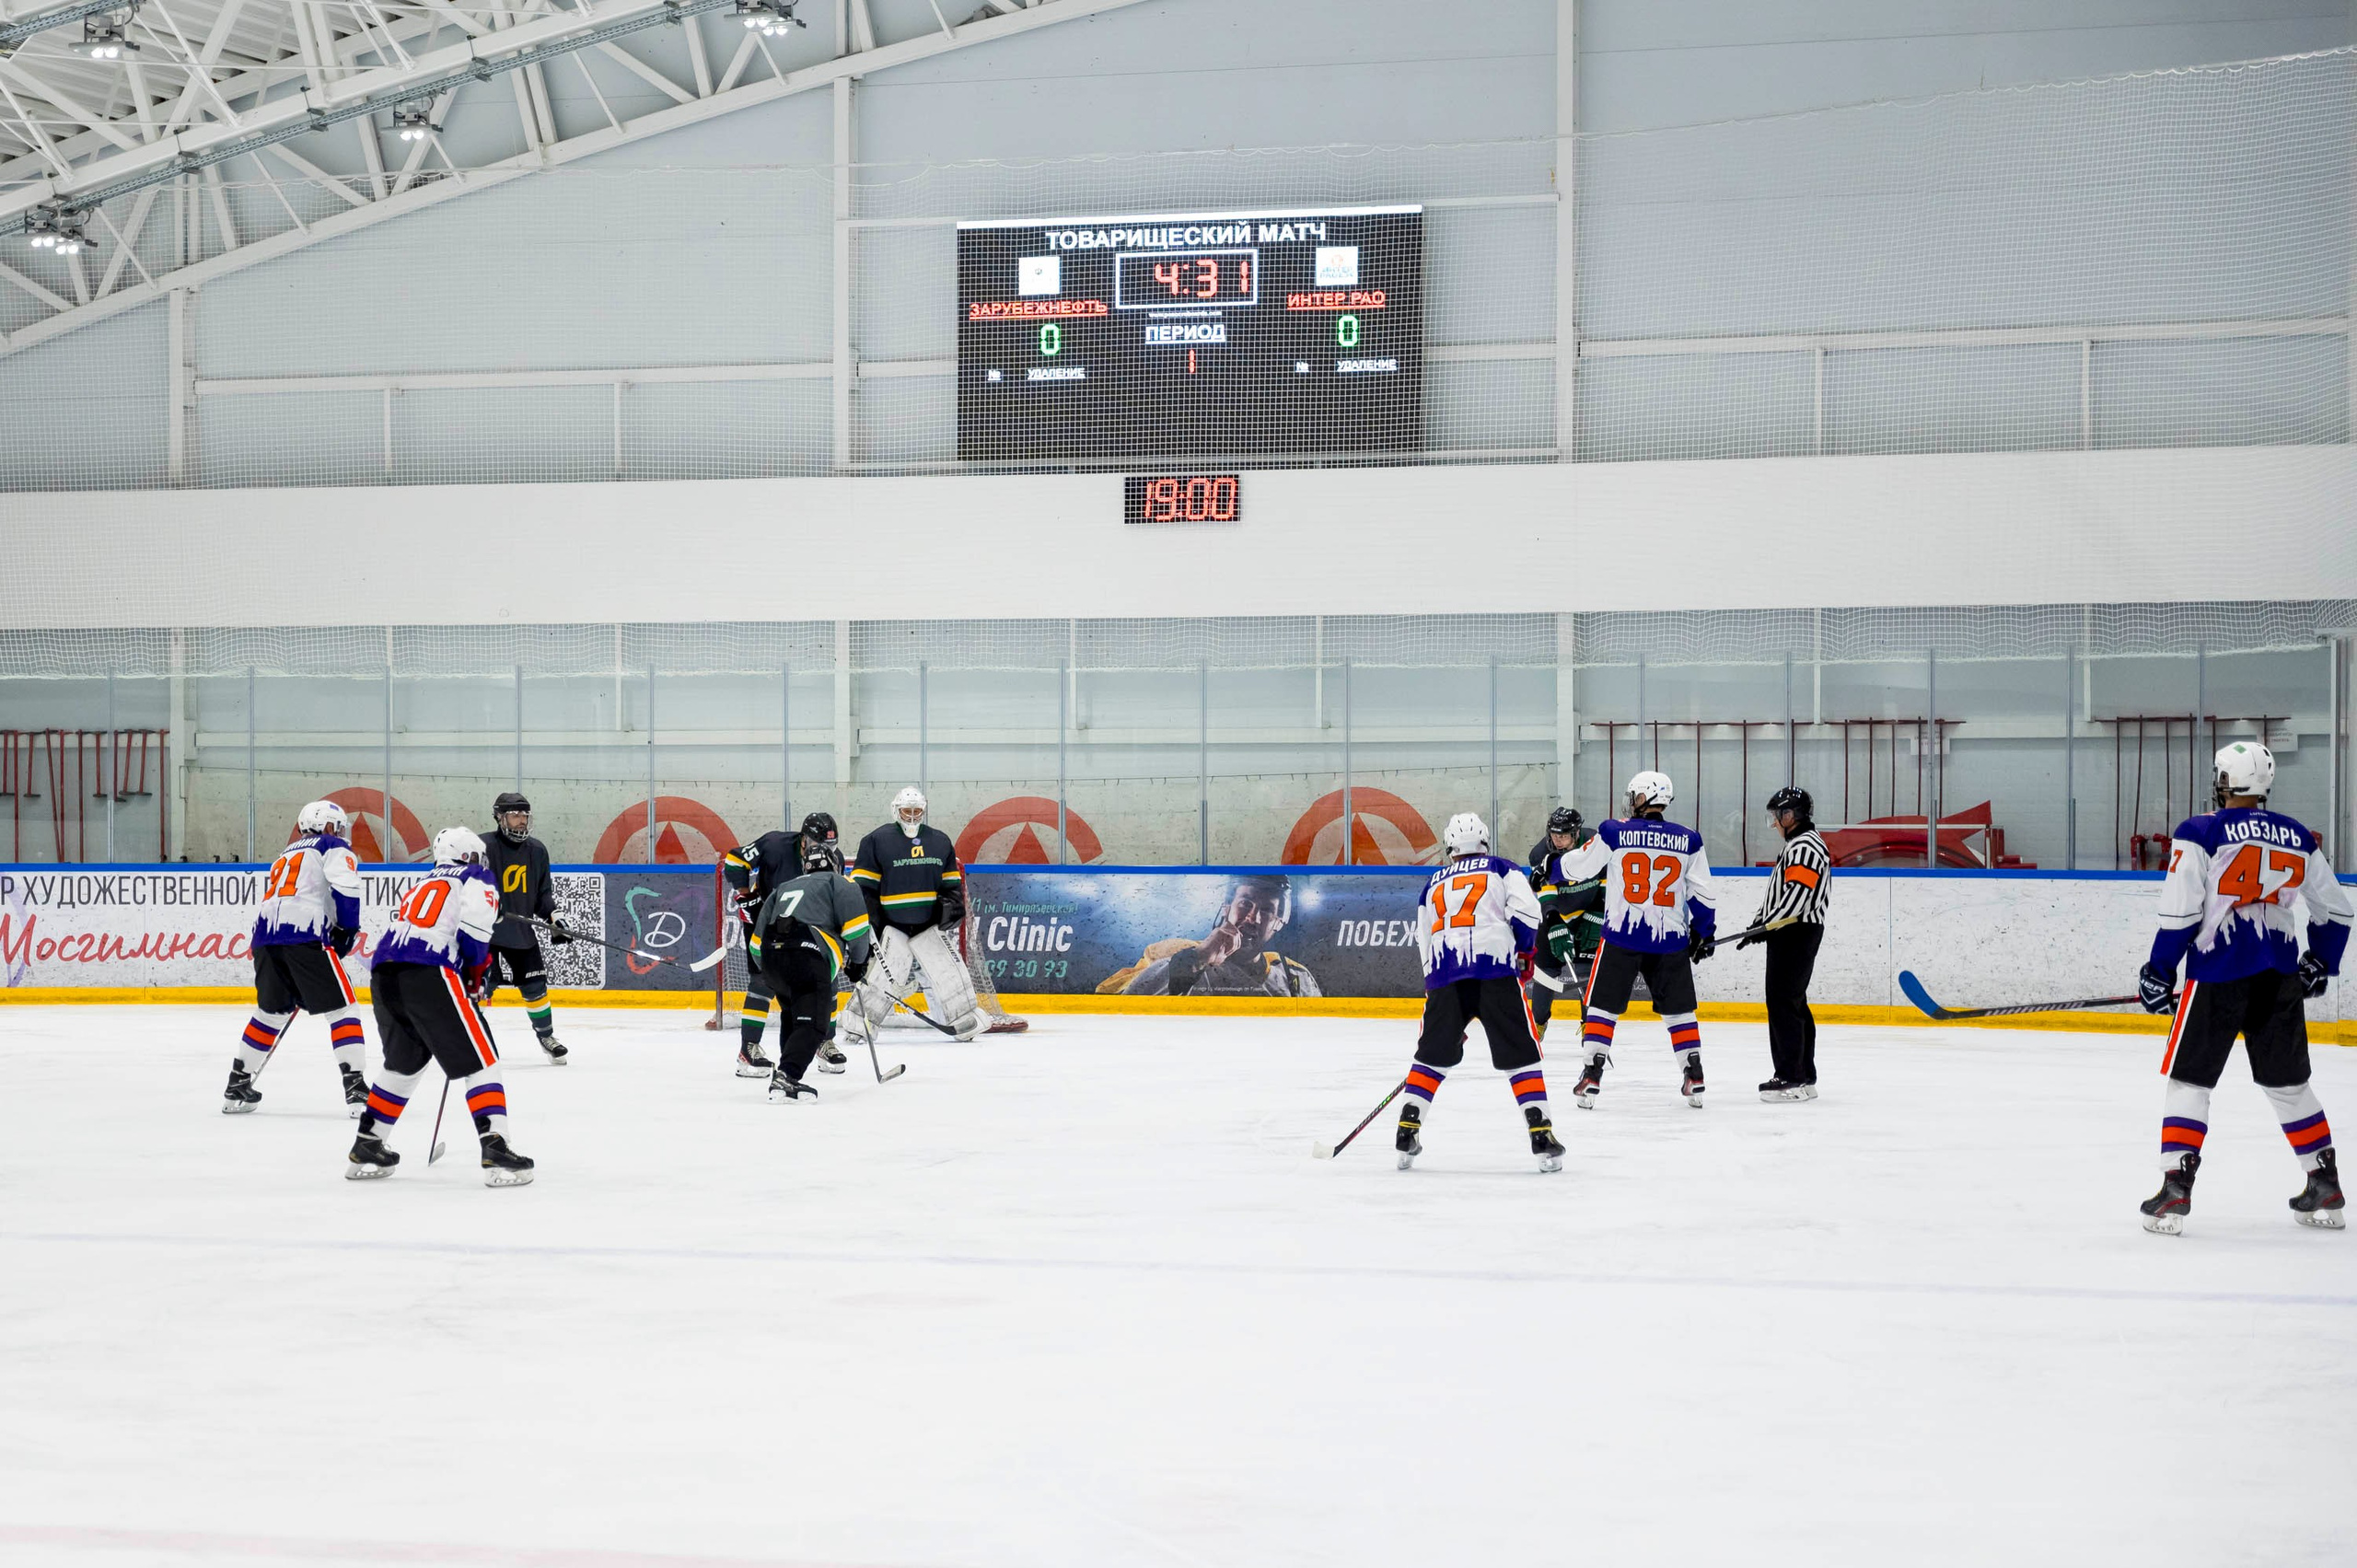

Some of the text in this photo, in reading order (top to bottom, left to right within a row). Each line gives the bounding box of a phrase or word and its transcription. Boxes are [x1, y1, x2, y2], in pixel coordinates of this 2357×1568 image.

[1045, 221, 1327, 250] ТОВАРИЩЕСКИЙ МАТЧ
[1155, 259, 1248, 297] 4:31
[970, 300, 1108, 317] ЗАРУБЕЖНЕФТЬ
[1287, 290, 1386, 308] ИНТЕР РАО
[1040, 323, 1061, 355] 0
[1144, 325, 1225, 342] ПЕРИОД
[1338, 314, 1359, 347] 0
[1027, 367, 1086, 379] УДАЛЕНИЕ
[1337, 359, 1398, 371] УДАЛЕНИЕ
[1144, 478, 1236, 521] 19:00
[1619, 830, 1689, 853] КОПТЕВСКИЙ
[2223, 820, 2302, 847] КОБЗАРЬ
[23, 871, 257, 909] ХУДОЖЕСТВЕННОЙ
[1621, 852, 1682, 908] 82
[2218, 844, 2306, 908] 47
[780, 889, 805, 918] 7
[1431, 873, 1489, 935] 17
[987, 916, 1074, 952] Clinic
[1337, 920, 1420, 947] ПОБЕЖ
[1014, 959, 1039, 979] 30
[1044, 959, 1069, 979] 93
